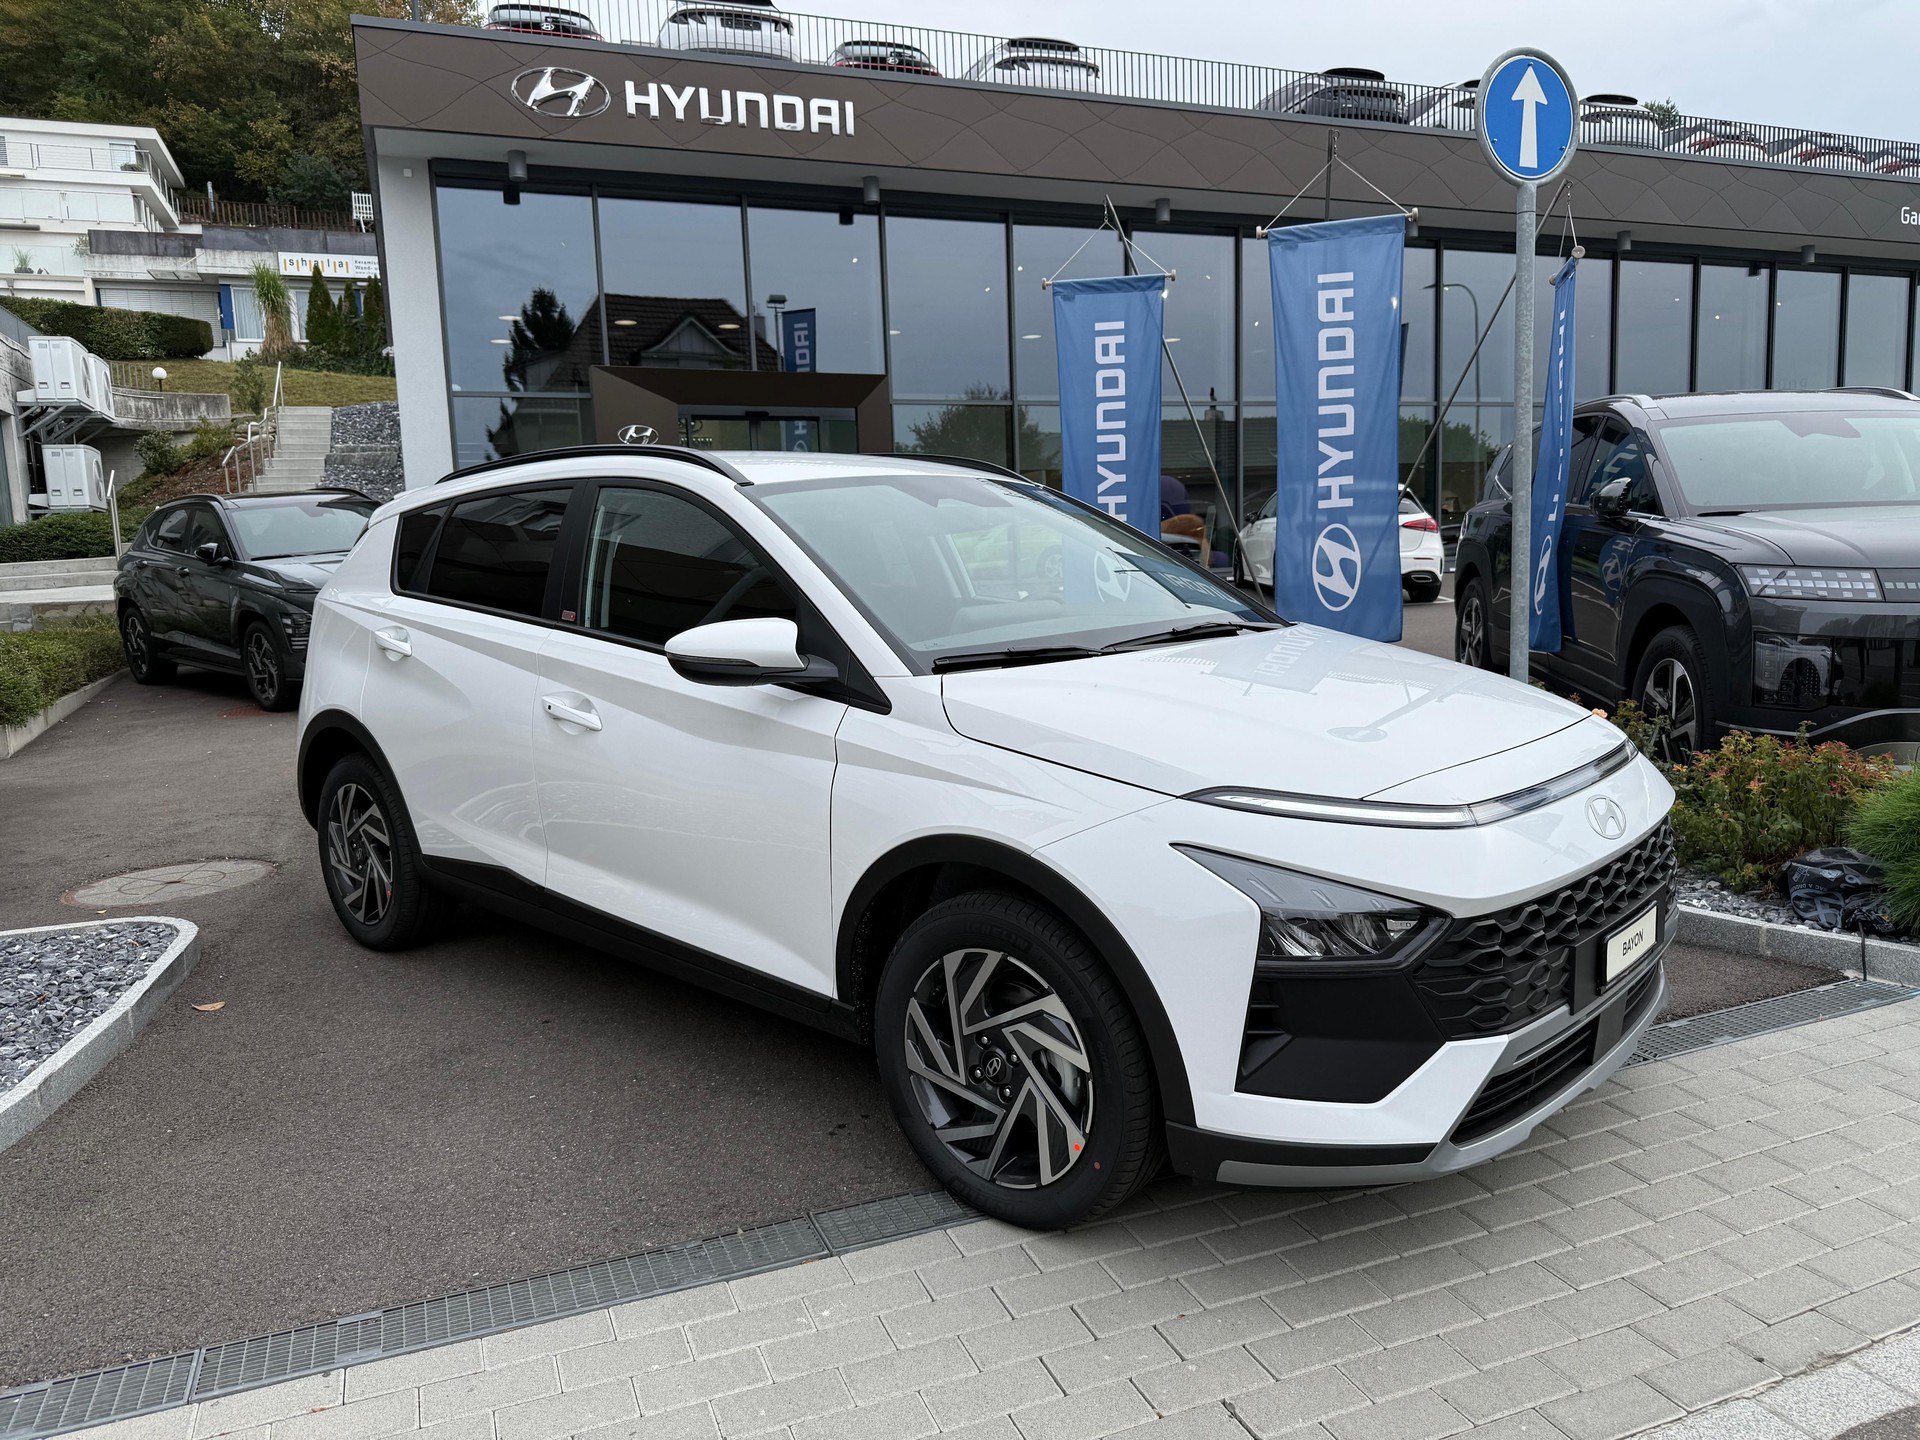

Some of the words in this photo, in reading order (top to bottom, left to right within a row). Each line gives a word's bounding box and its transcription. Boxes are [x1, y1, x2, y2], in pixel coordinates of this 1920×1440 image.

[625, 80, 855, 136] HYUNDAI
[1094, 320, 1128, 522] HYUNDAI
[1317, 271, 1355, 509] HYUNDAI
[1622, 928, 1644, 957] BAYON
